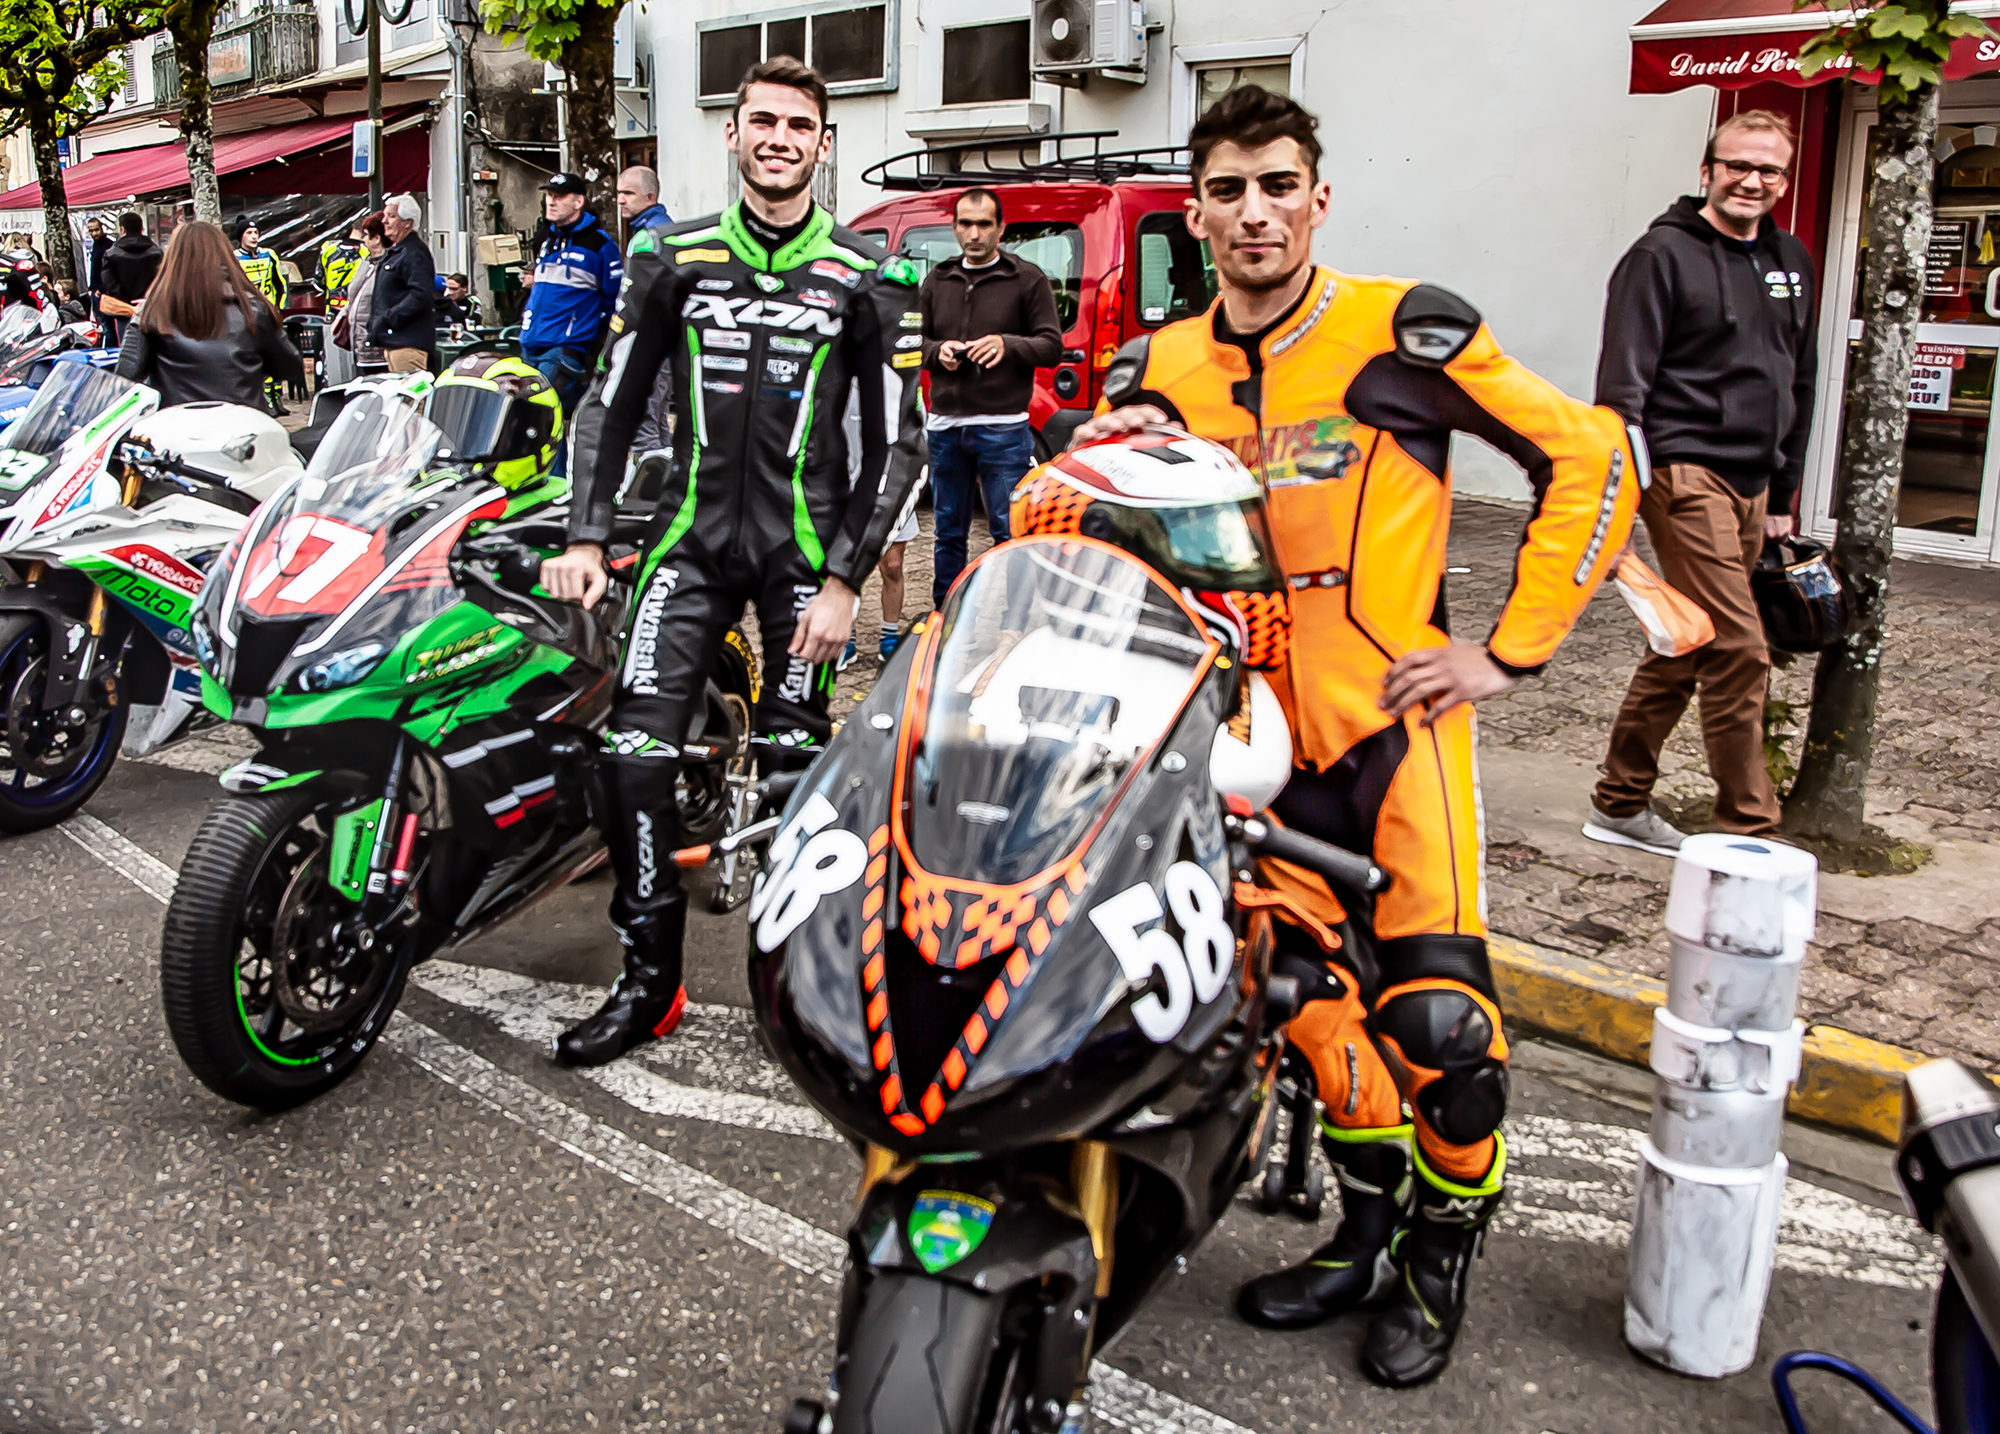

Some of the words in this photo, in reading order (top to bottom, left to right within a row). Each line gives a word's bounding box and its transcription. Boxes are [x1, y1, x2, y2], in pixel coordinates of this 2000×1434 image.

[1669, 51, 1751, 77] David
[1913, 354, 1954, 366] MEDI
[242, 515, 374, 605] 17
[632, 566, 680, 695] Kawasaki
[748, 790, 869, 954] 58
[1087, 860, 1236, 1044] 58
